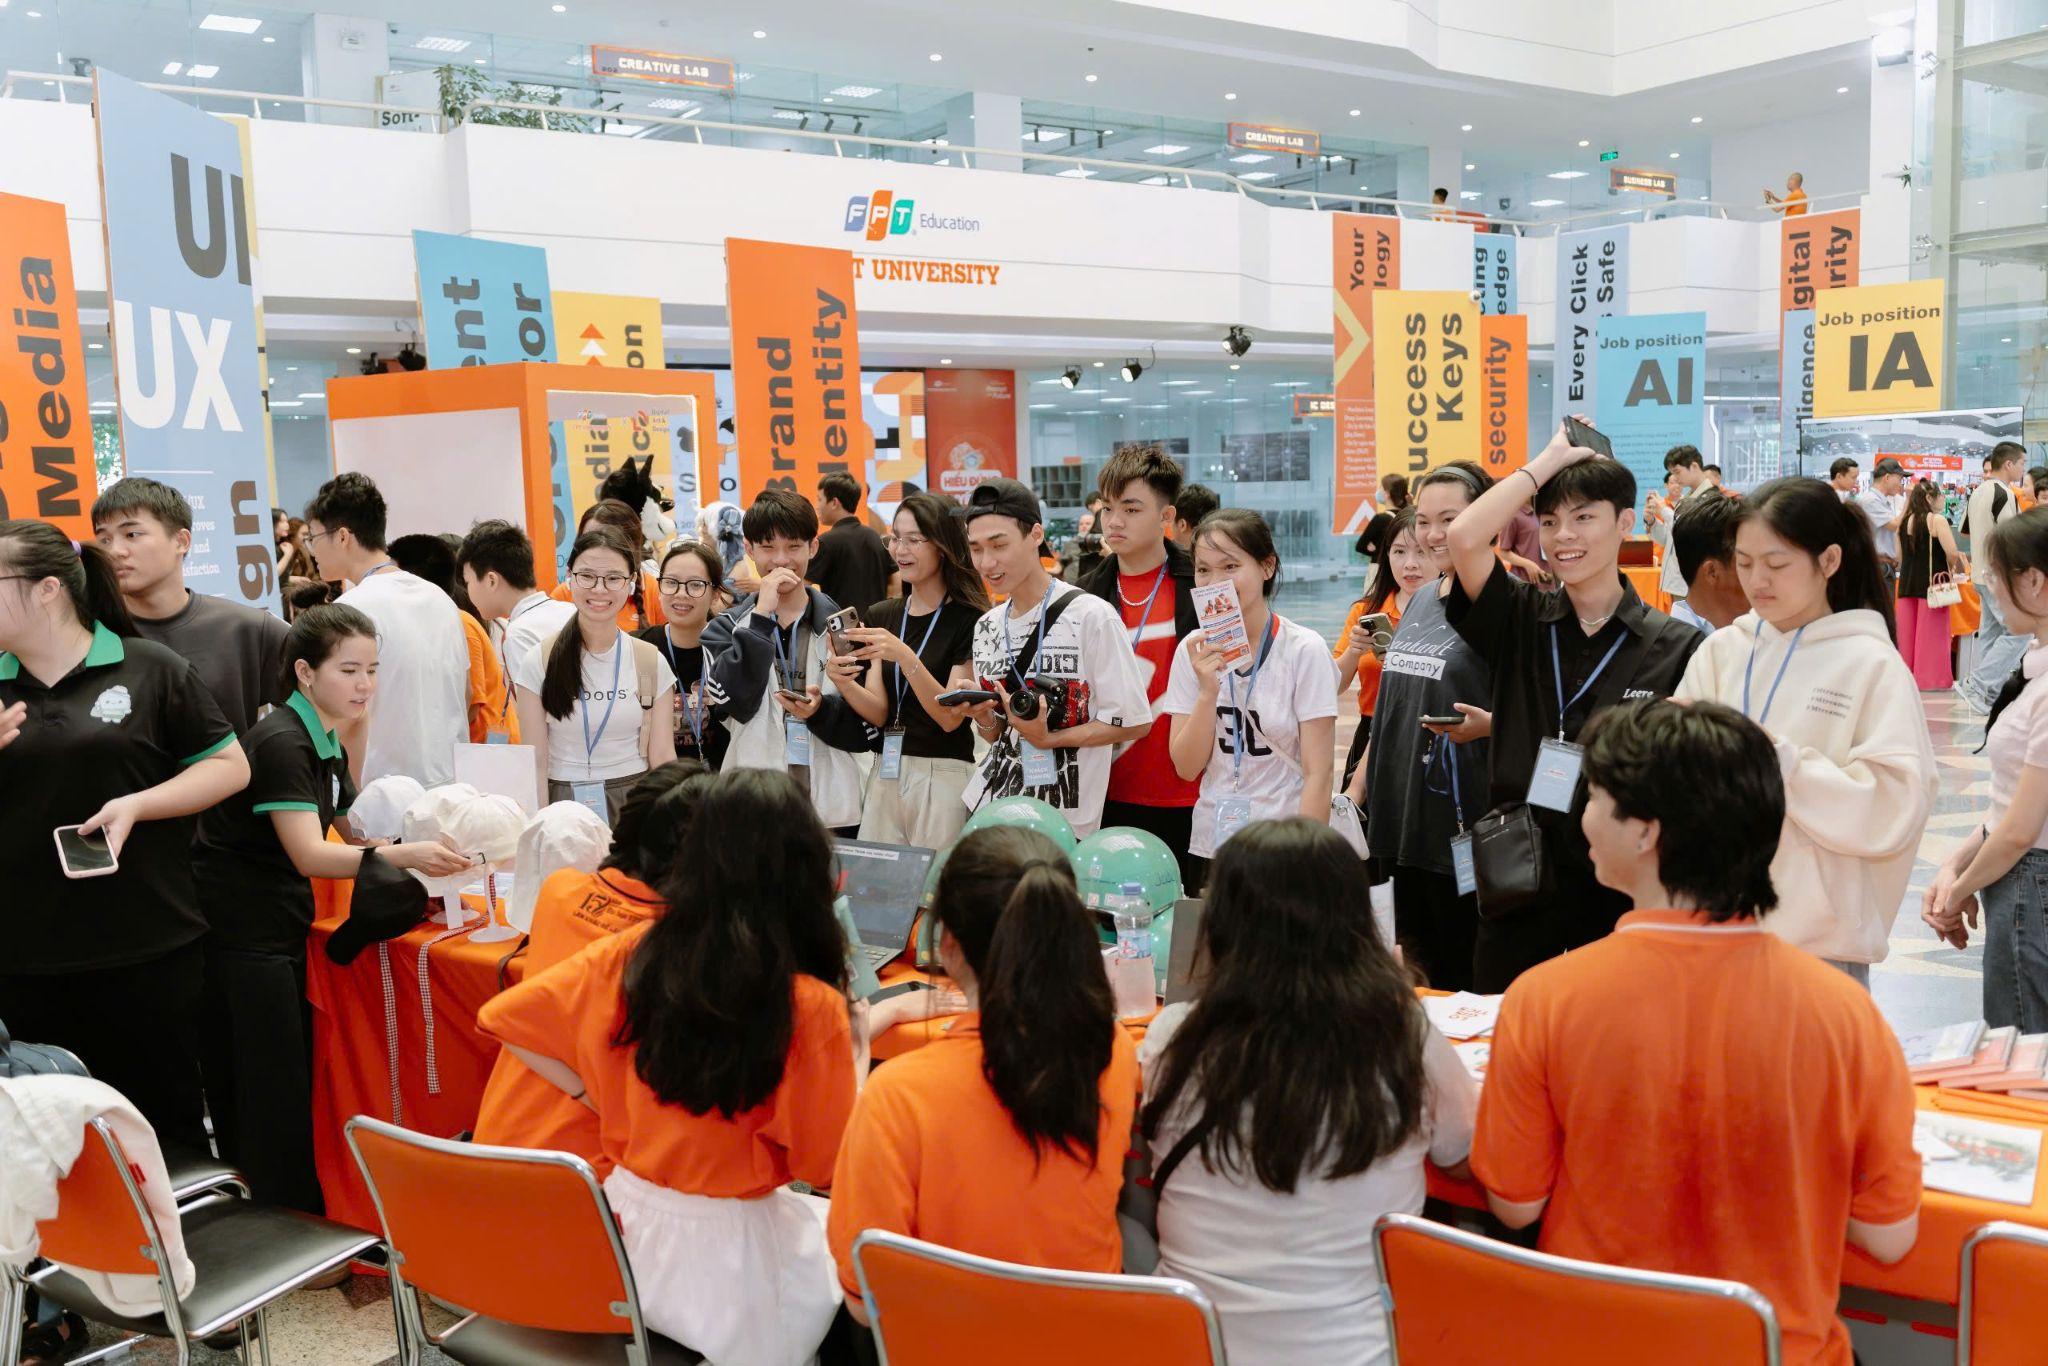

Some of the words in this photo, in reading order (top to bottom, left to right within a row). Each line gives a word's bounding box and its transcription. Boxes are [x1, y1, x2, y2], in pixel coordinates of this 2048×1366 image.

[618, 57, 681, 75] CREATIVE
[684, 65, 709, 78] LAB
[1245, 131, 1285, 146] CREATIVE
[1287, 136, 1304, 147] LAB
[171, 152, 252, 287] UI
[919, 213, 980, 232] Education
[872, 259, 1000, 286] UNIVERSITY
[1350, 228, 1365, 292] Your
[1570, 243, 1589, 315] Click
[1597, 240, 1616, 303] Safe
[1824, 226, 1853, 289] rity
[1600, 337, 1630, 349] Job
[1635, 334, 1703, 351] position
[1819, 313, 1854, 326] Job
[1861, 306, 1941, 326] position
[13, 256, 82, 517] Media
[113, 300, 244, 432] UX
[1437, 312, 1468, 422] Keys
[1568, 324, 1589, 401] Every
[1623, 357, 1694, 408] AI
[1848, 331, 1934, 392] IA
[1484, 336, 1512, 465] security
[1390, 654, 1441, 677] Company
